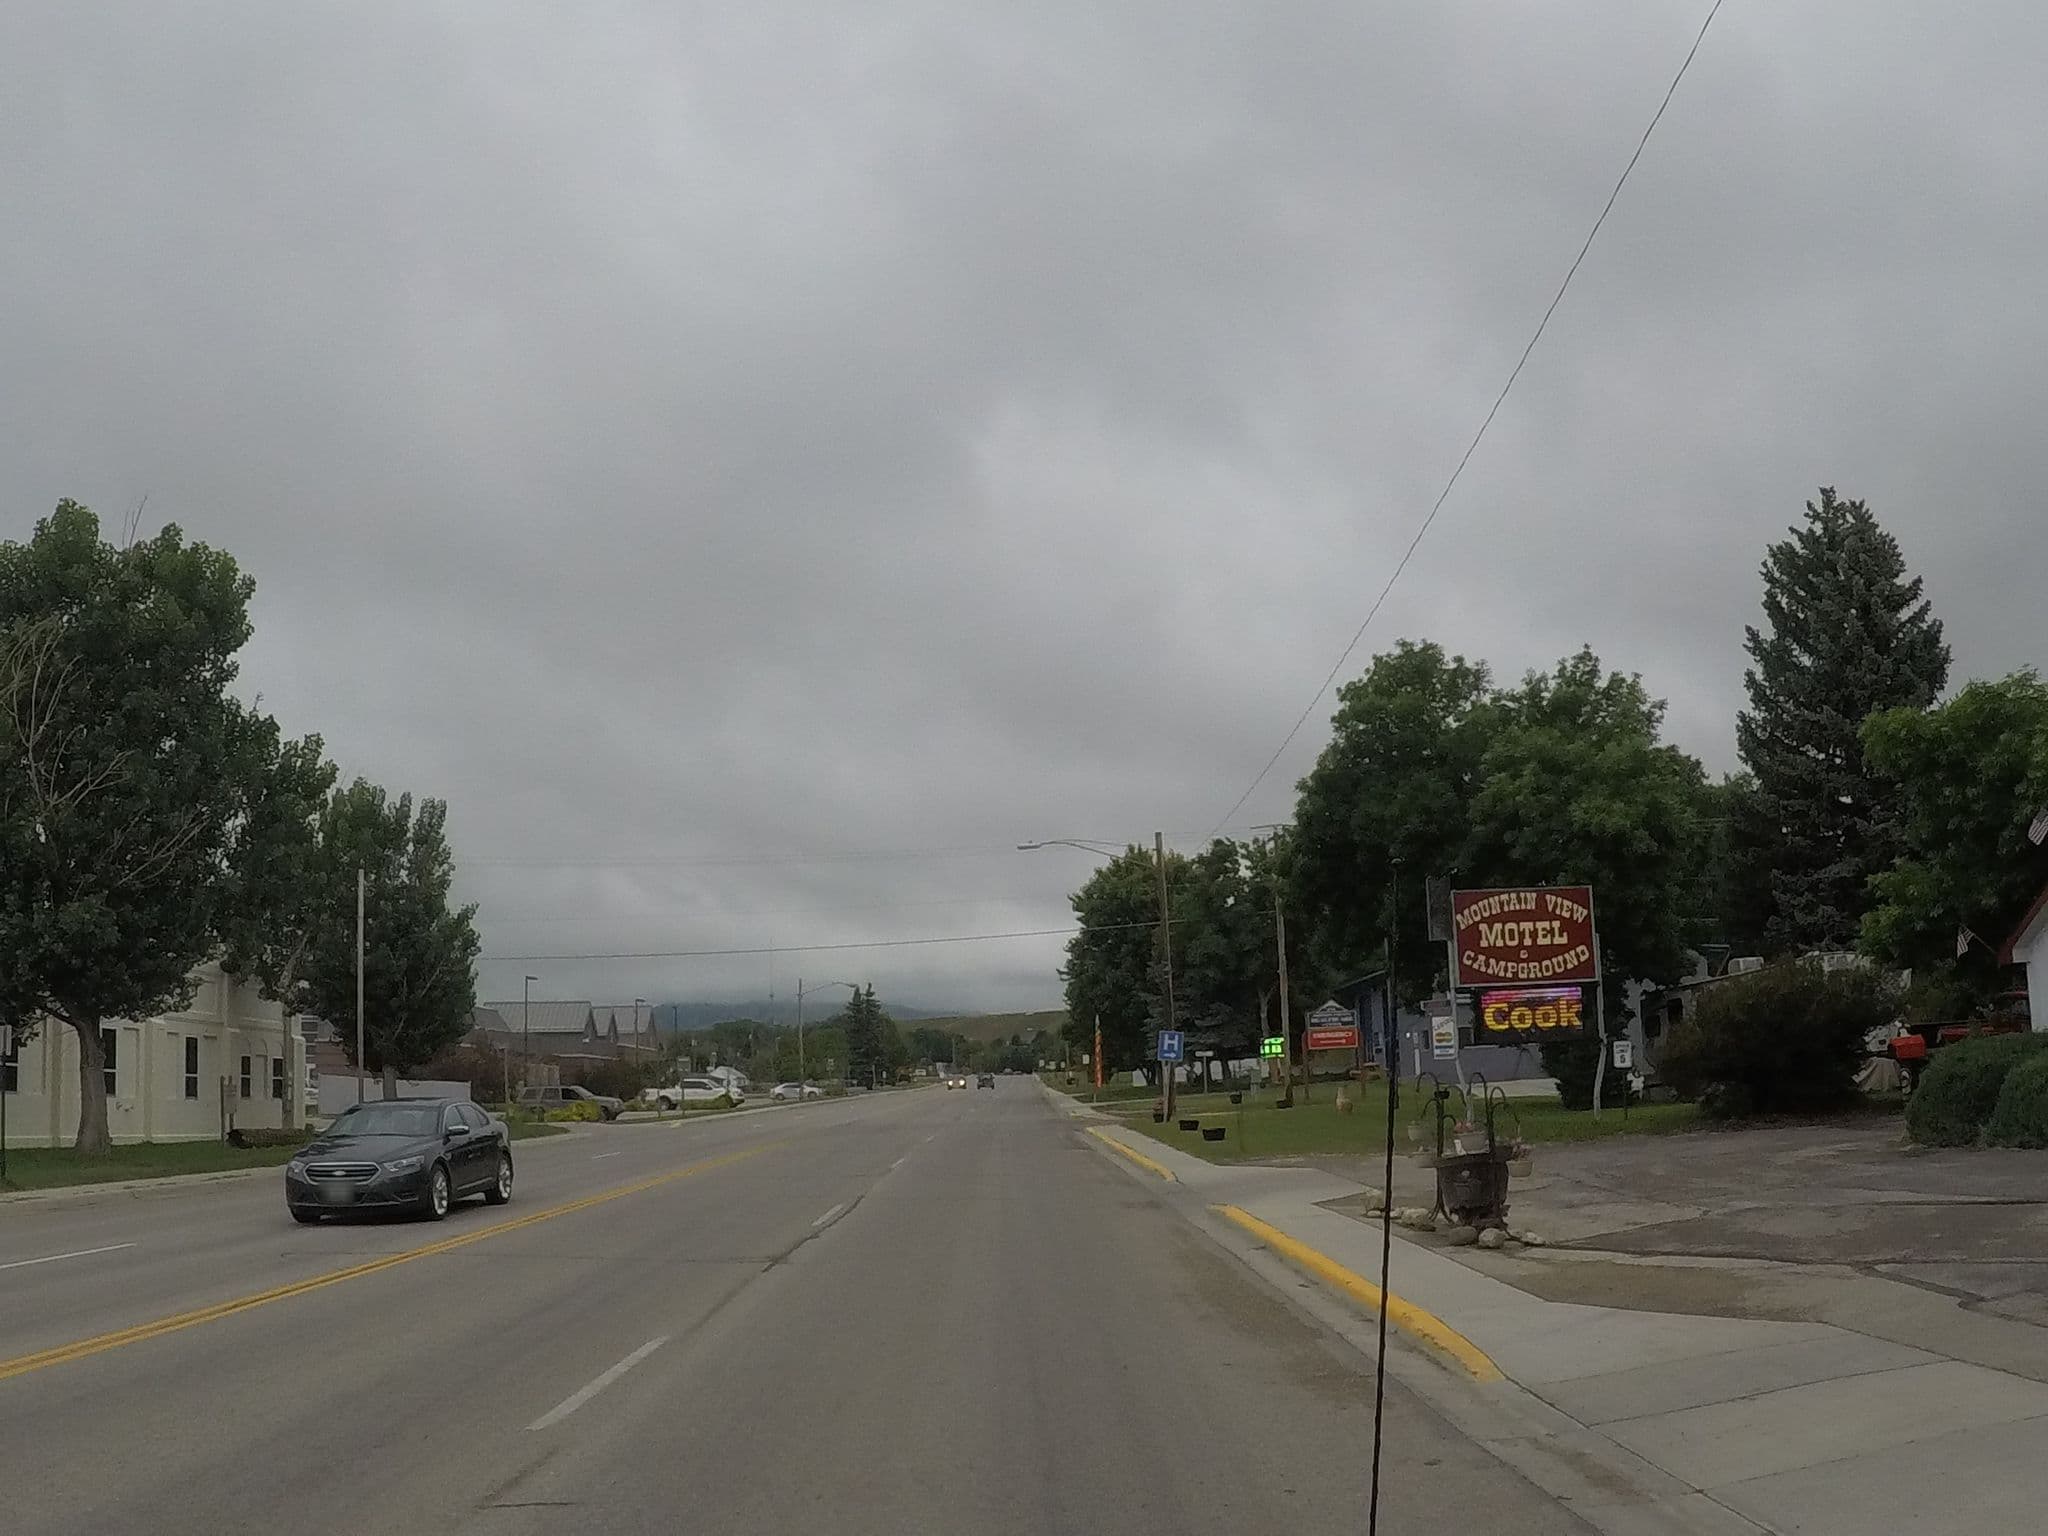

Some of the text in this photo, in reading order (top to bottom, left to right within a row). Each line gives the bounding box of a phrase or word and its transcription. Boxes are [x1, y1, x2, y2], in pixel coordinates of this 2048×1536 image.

[1456, 892, 1588, 930] MOUNTAIN VIEW
[1478, 920, 1568, 947] MOTEL
[1462, 944, 1590, 979] CAMPGROUND
[1484, 997, 1583, 1030] Cook
[1163, 1034, 1179, 1051] H
